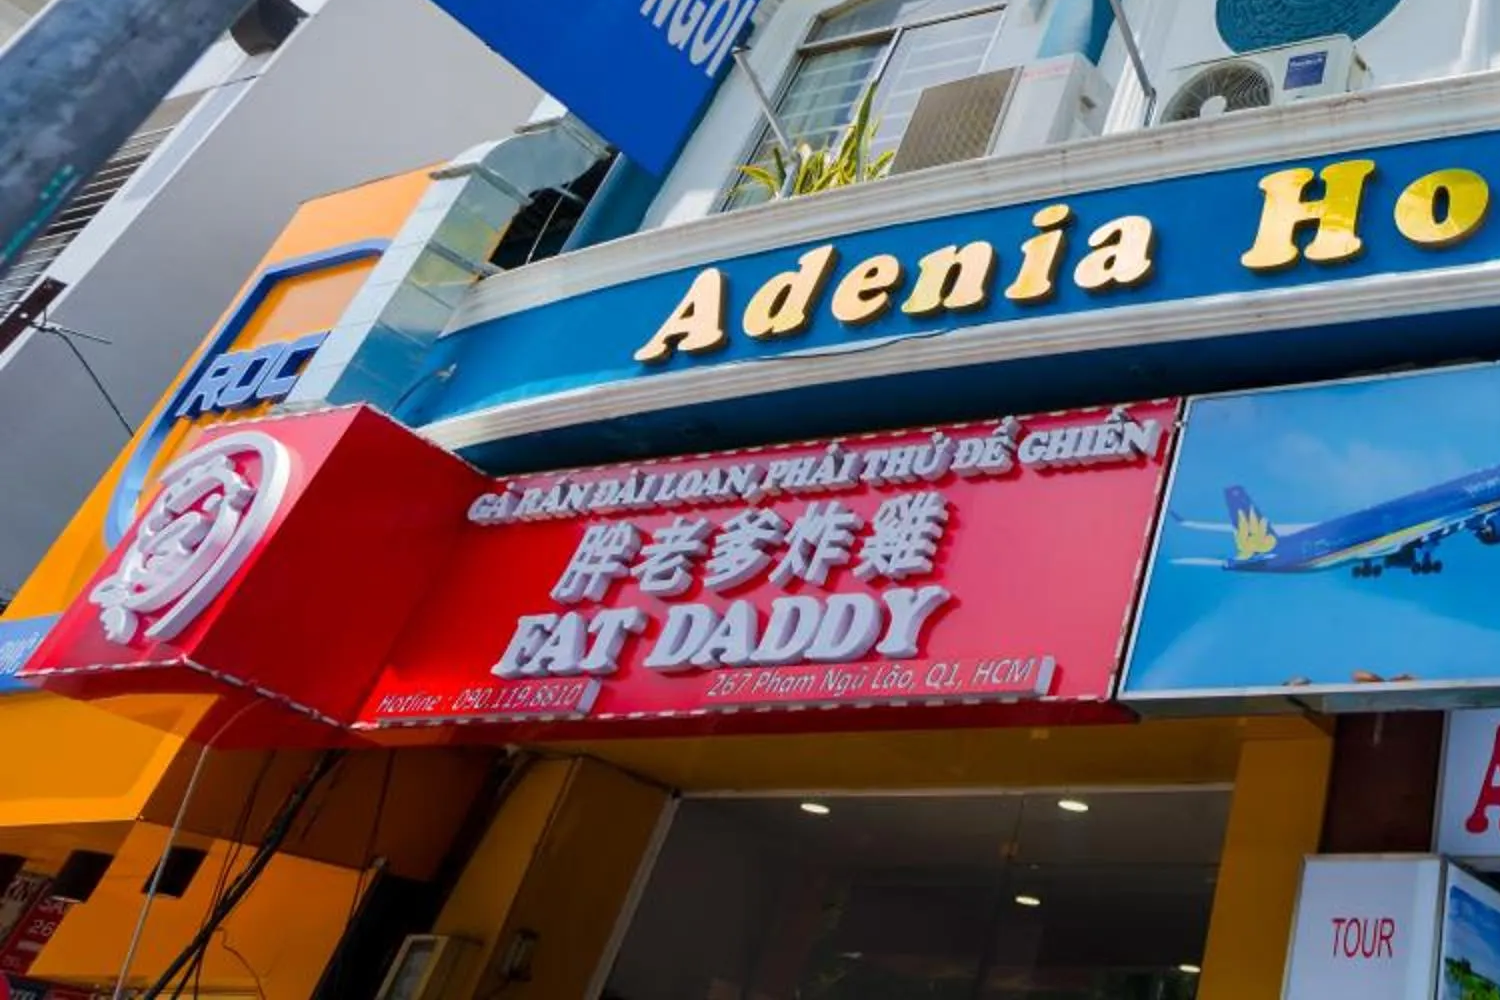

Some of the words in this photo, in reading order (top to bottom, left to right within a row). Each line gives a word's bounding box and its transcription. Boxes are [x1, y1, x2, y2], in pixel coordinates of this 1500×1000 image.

[633, 203, 1157, 363] Adenia
[491, 607, 647, 679] FAT
[643, 586, 951, 671] DADDY
[708, 672, 750, 697] 267
[973, 658, 1036, 684] HCM
[1331, 917, 1395, 958] TOUR
